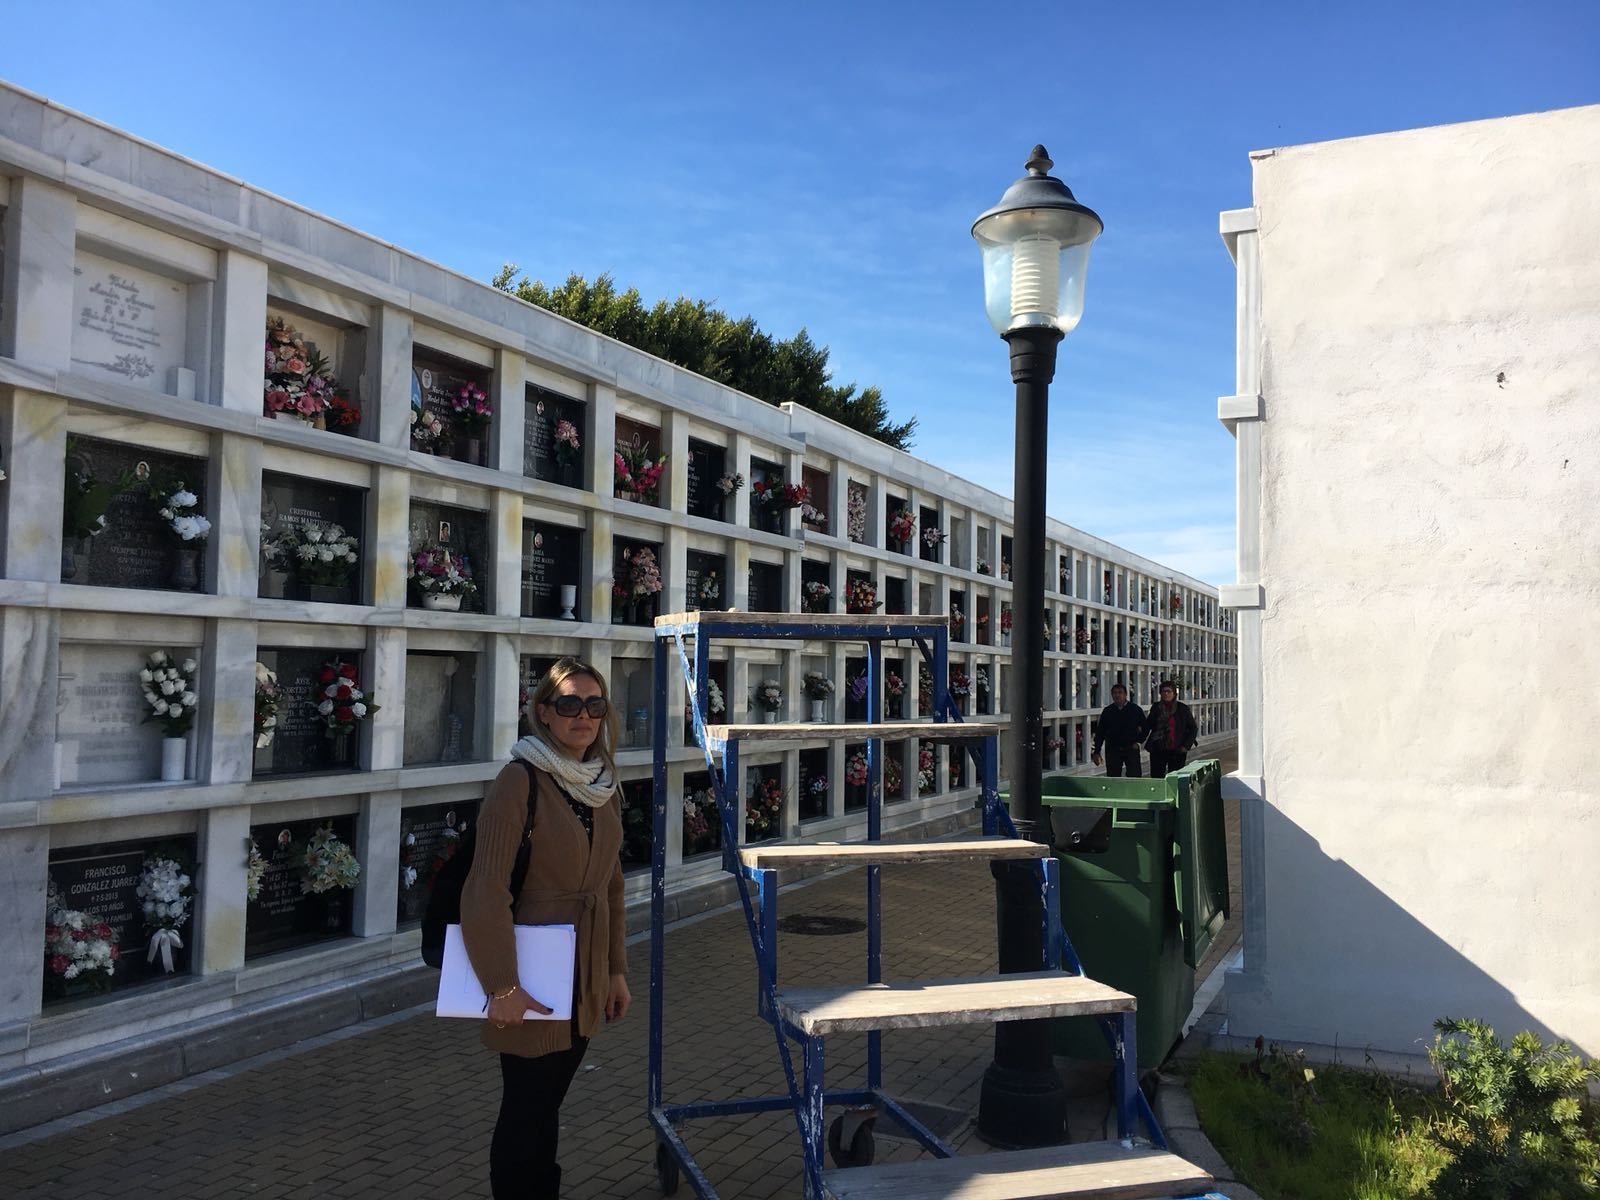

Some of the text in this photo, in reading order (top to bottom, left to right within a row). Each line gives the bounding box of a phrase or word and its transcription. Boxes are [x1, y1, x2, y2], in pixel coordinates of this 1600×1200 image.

[85, 865, 126, 879] FRANCISCO
[71, 876, 138, 895] GONZALEZ JUAREZ
